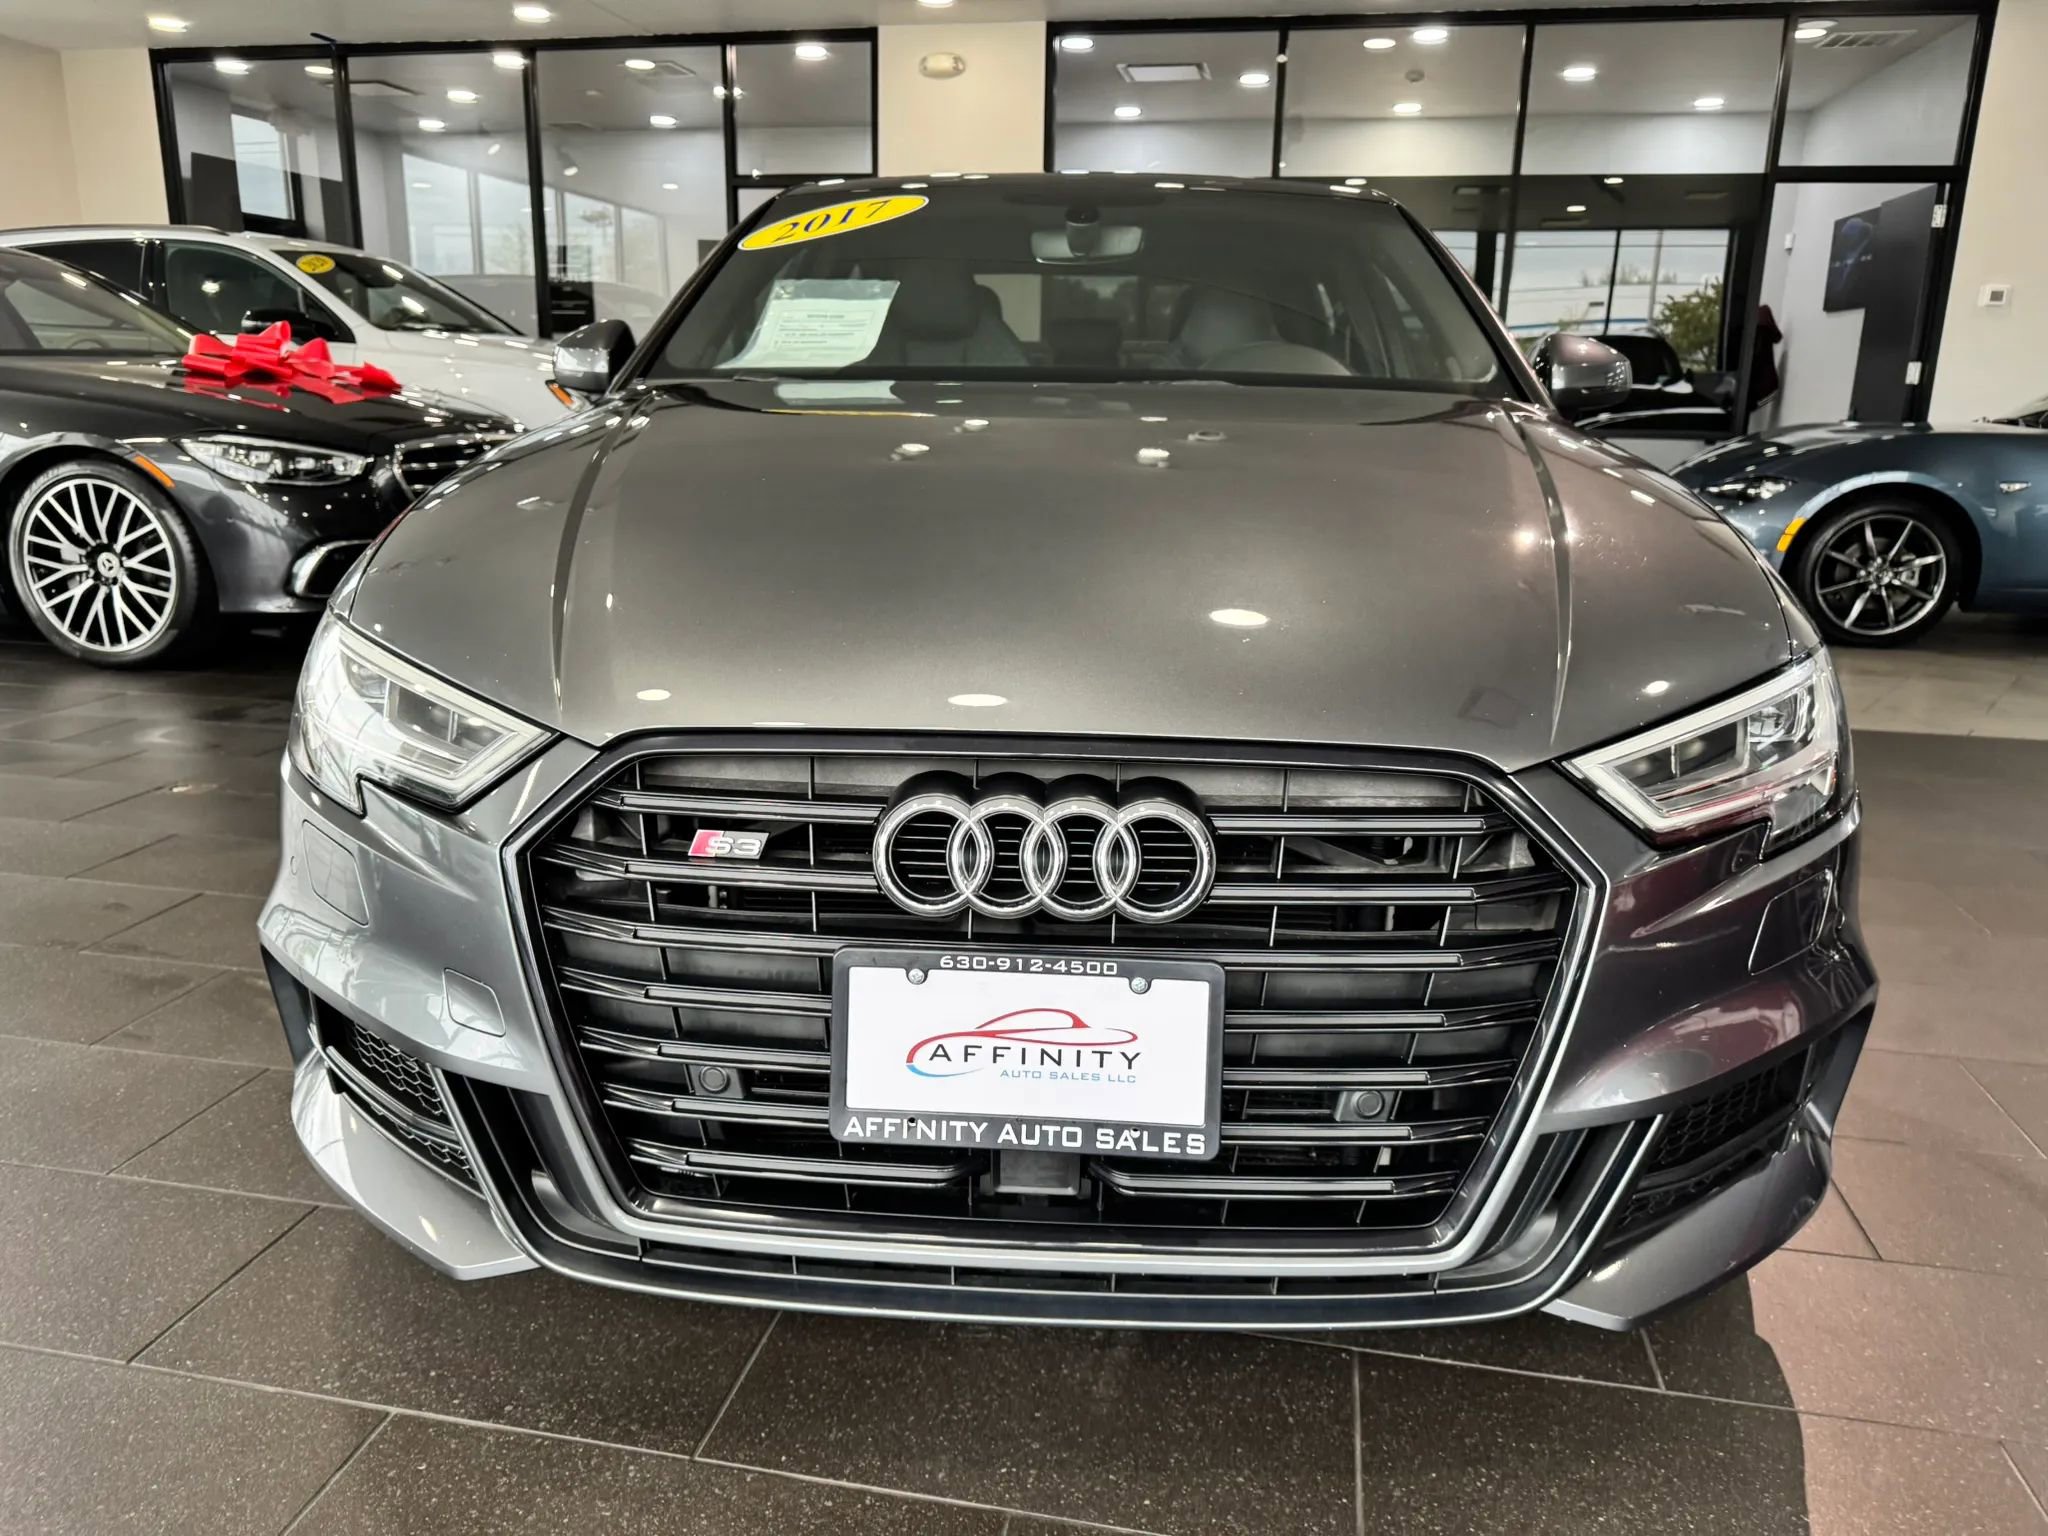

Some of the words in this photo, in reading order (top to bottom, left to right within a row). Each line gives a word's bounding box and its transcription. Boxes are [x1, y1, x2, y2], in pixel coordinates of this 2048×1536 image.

[774, 200, 892, 243] 2017
[706, 837, 761, 856] S3
[939, 955, 1118, 975] 630-912-4500
[929, 1043, 1141, 1070] AFFINITY
[1000, 1069, 1042, 1080] AUTO
[1048, 1072, 1101, 1083] SALES
[1107, 1075, 1136, 1084] LLC
[844, 1116, 988, 1143] AFFINITY
[997, 1122, 1083, 1148] AUTO
[1095, 1128, 1206, 1155] SALES
